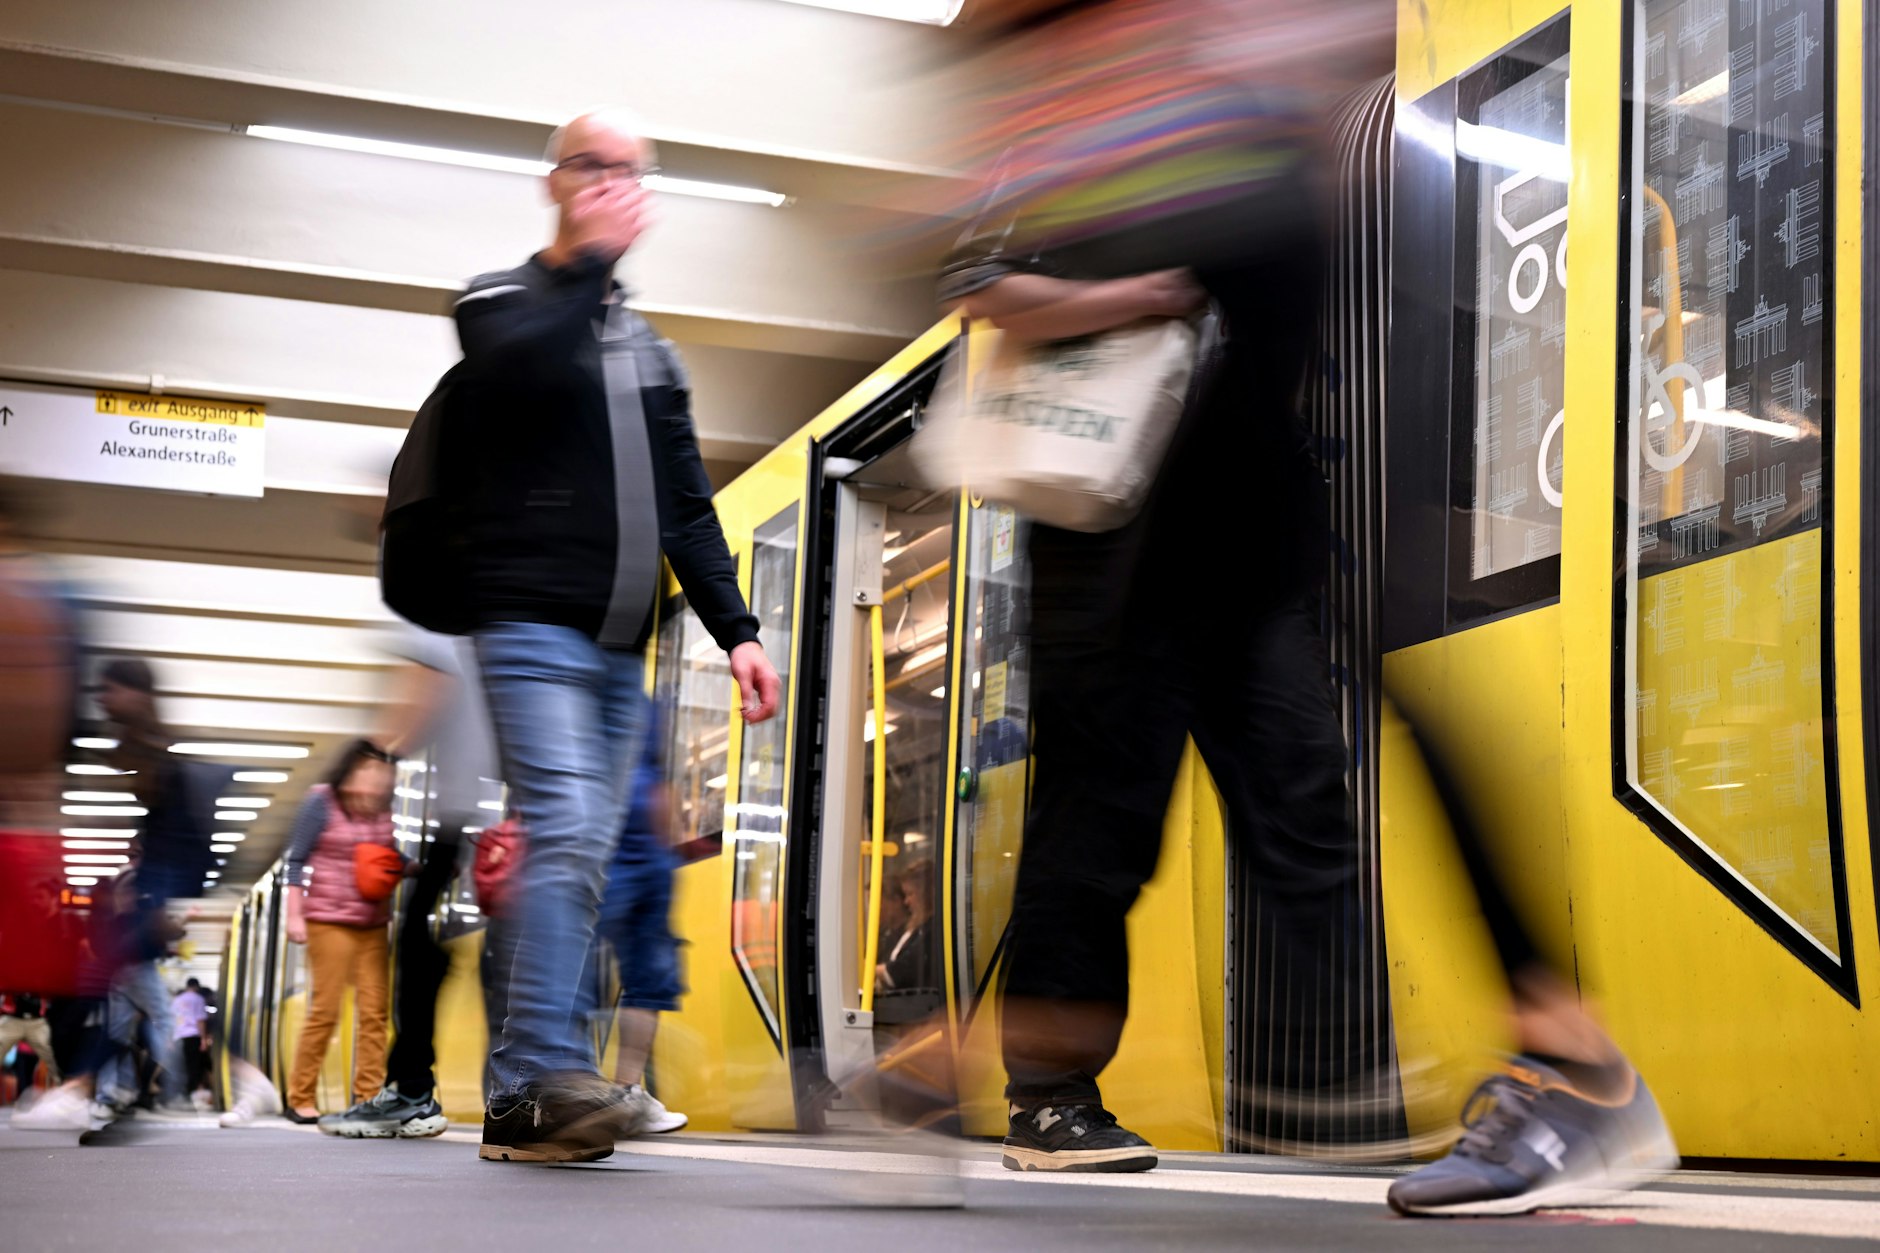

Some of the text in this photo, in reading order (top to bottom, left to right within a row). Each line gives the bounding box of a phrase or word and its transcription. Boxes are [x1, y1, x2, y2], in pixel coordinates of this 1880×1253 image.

[128, 399, 239, 424] exit Ausgang
[129, 420, 238, 444] Grunerstraße
[100, 440, 236, 467] Alexanderstraße
